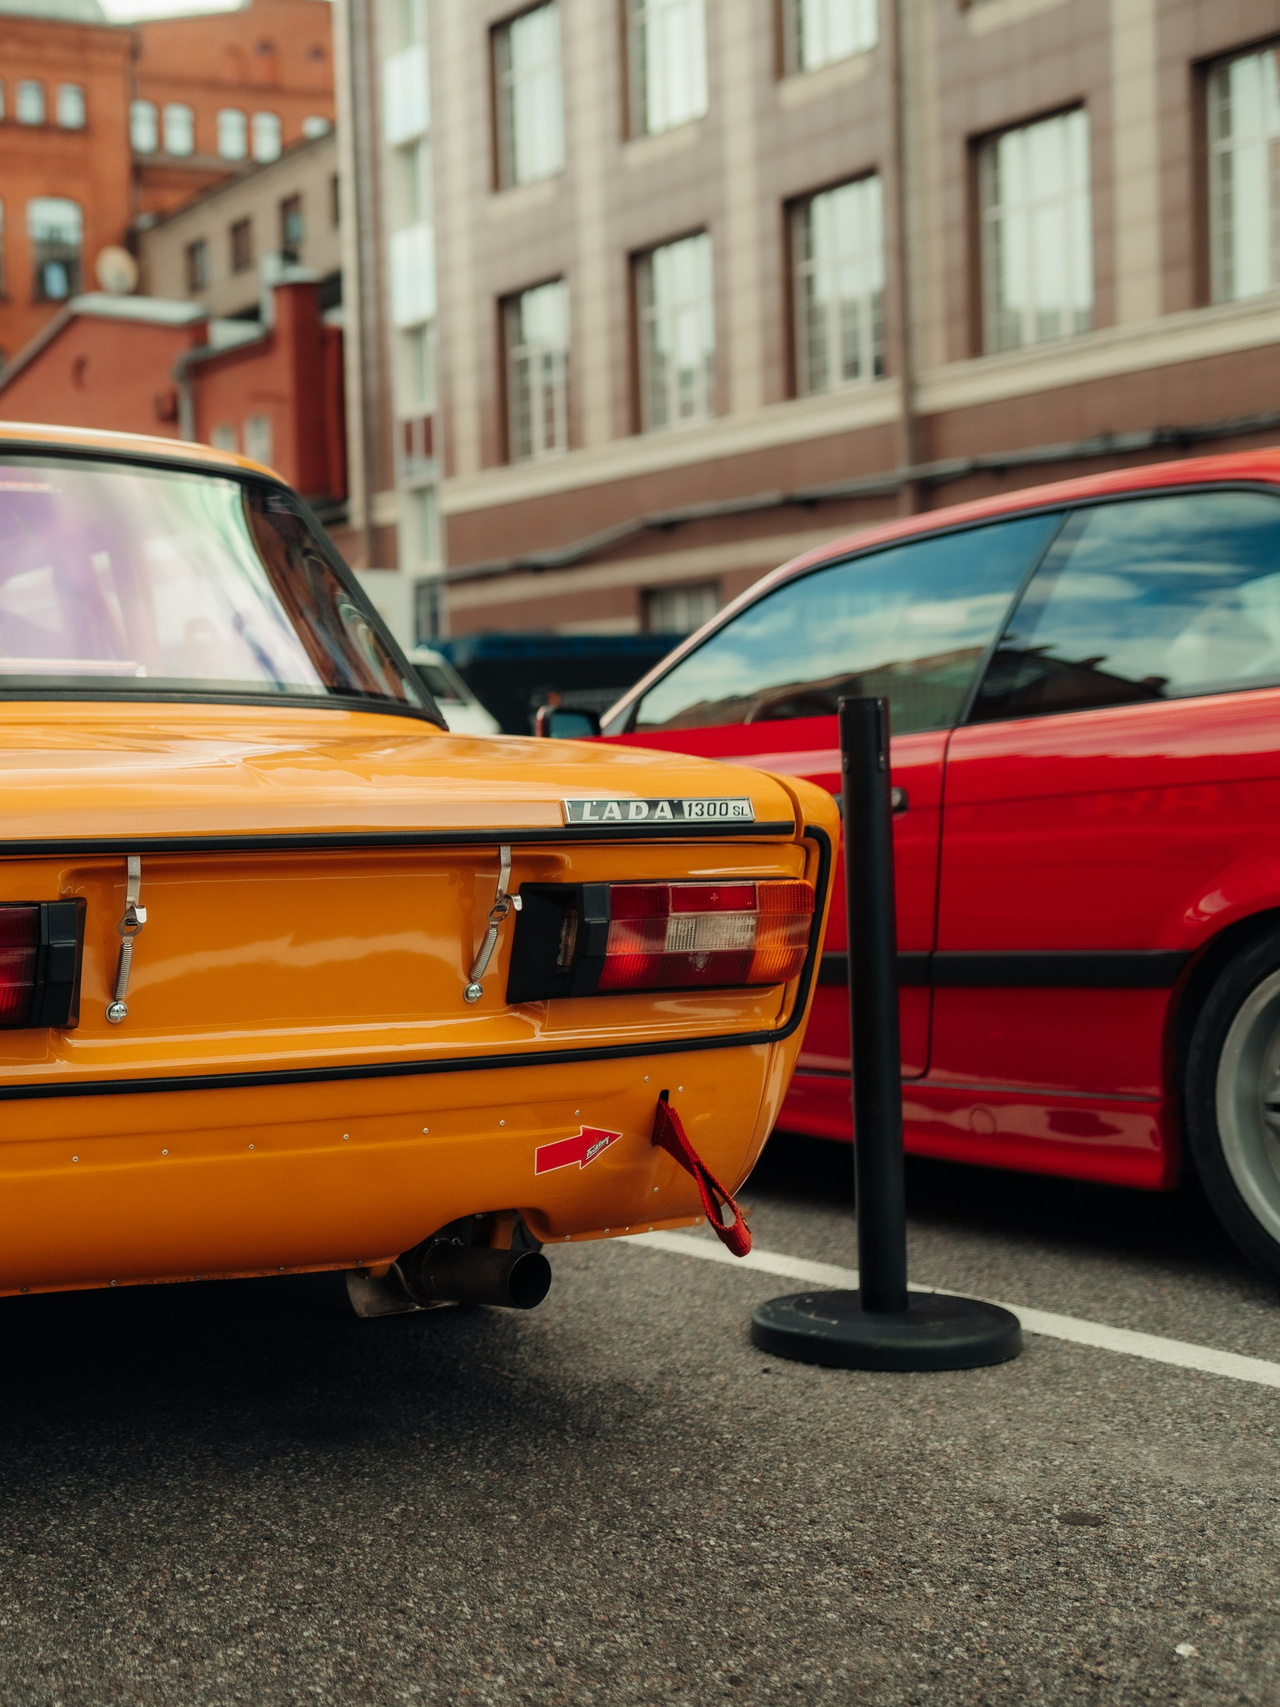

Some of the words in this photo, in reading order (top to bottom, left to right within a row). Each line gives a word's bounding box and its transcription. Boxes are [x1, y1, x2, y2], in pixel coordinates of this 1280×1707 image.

[581, 801, 673, 821] LADA
[687, 802, 729, 818] 1300
[732, 805, 749, 817] SL
